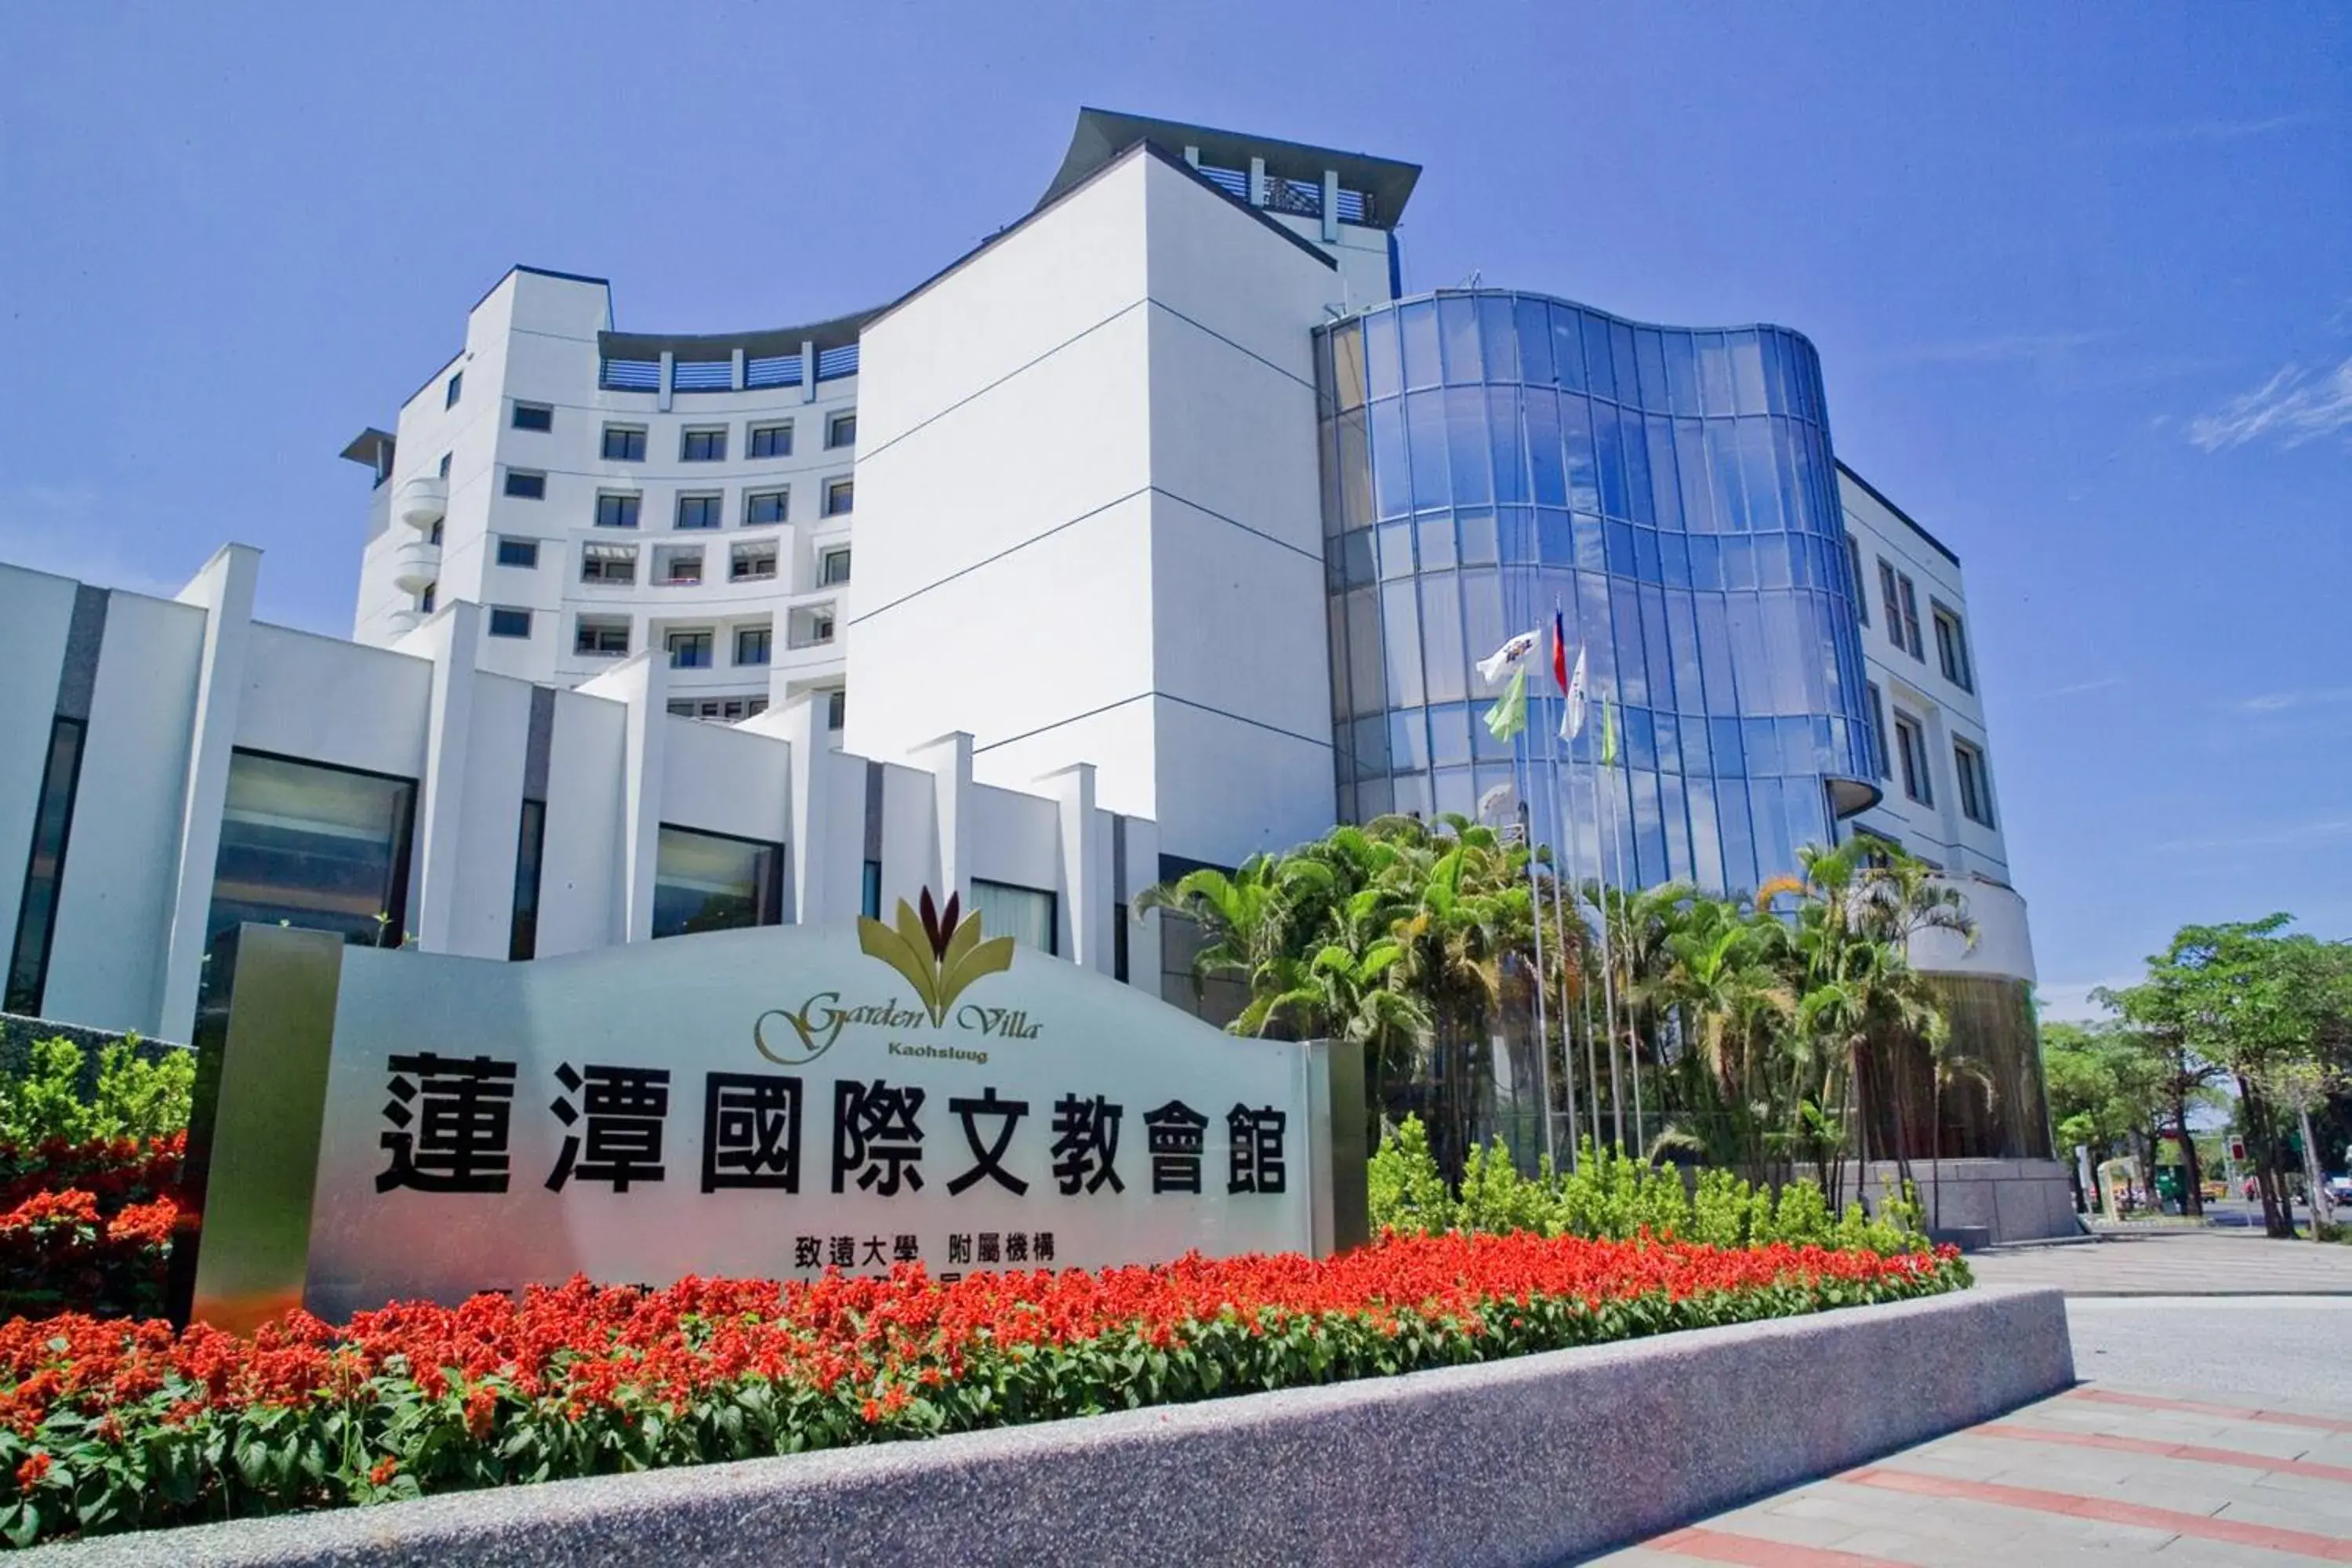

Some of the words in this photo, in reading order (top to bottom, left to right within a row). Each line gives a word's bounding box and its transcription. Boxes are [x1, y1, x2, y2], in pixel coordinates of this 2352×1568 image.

[754, 992, 924, 1065] Garden
[957, 1004, 1044, 1040] Villa
[376, 1052, 1286, 1196] 蓮潭國際文教會館
[795, 1235, 919, 1268] 致遠大學
[948, 1232, 1055, 1263] 附屬機構
